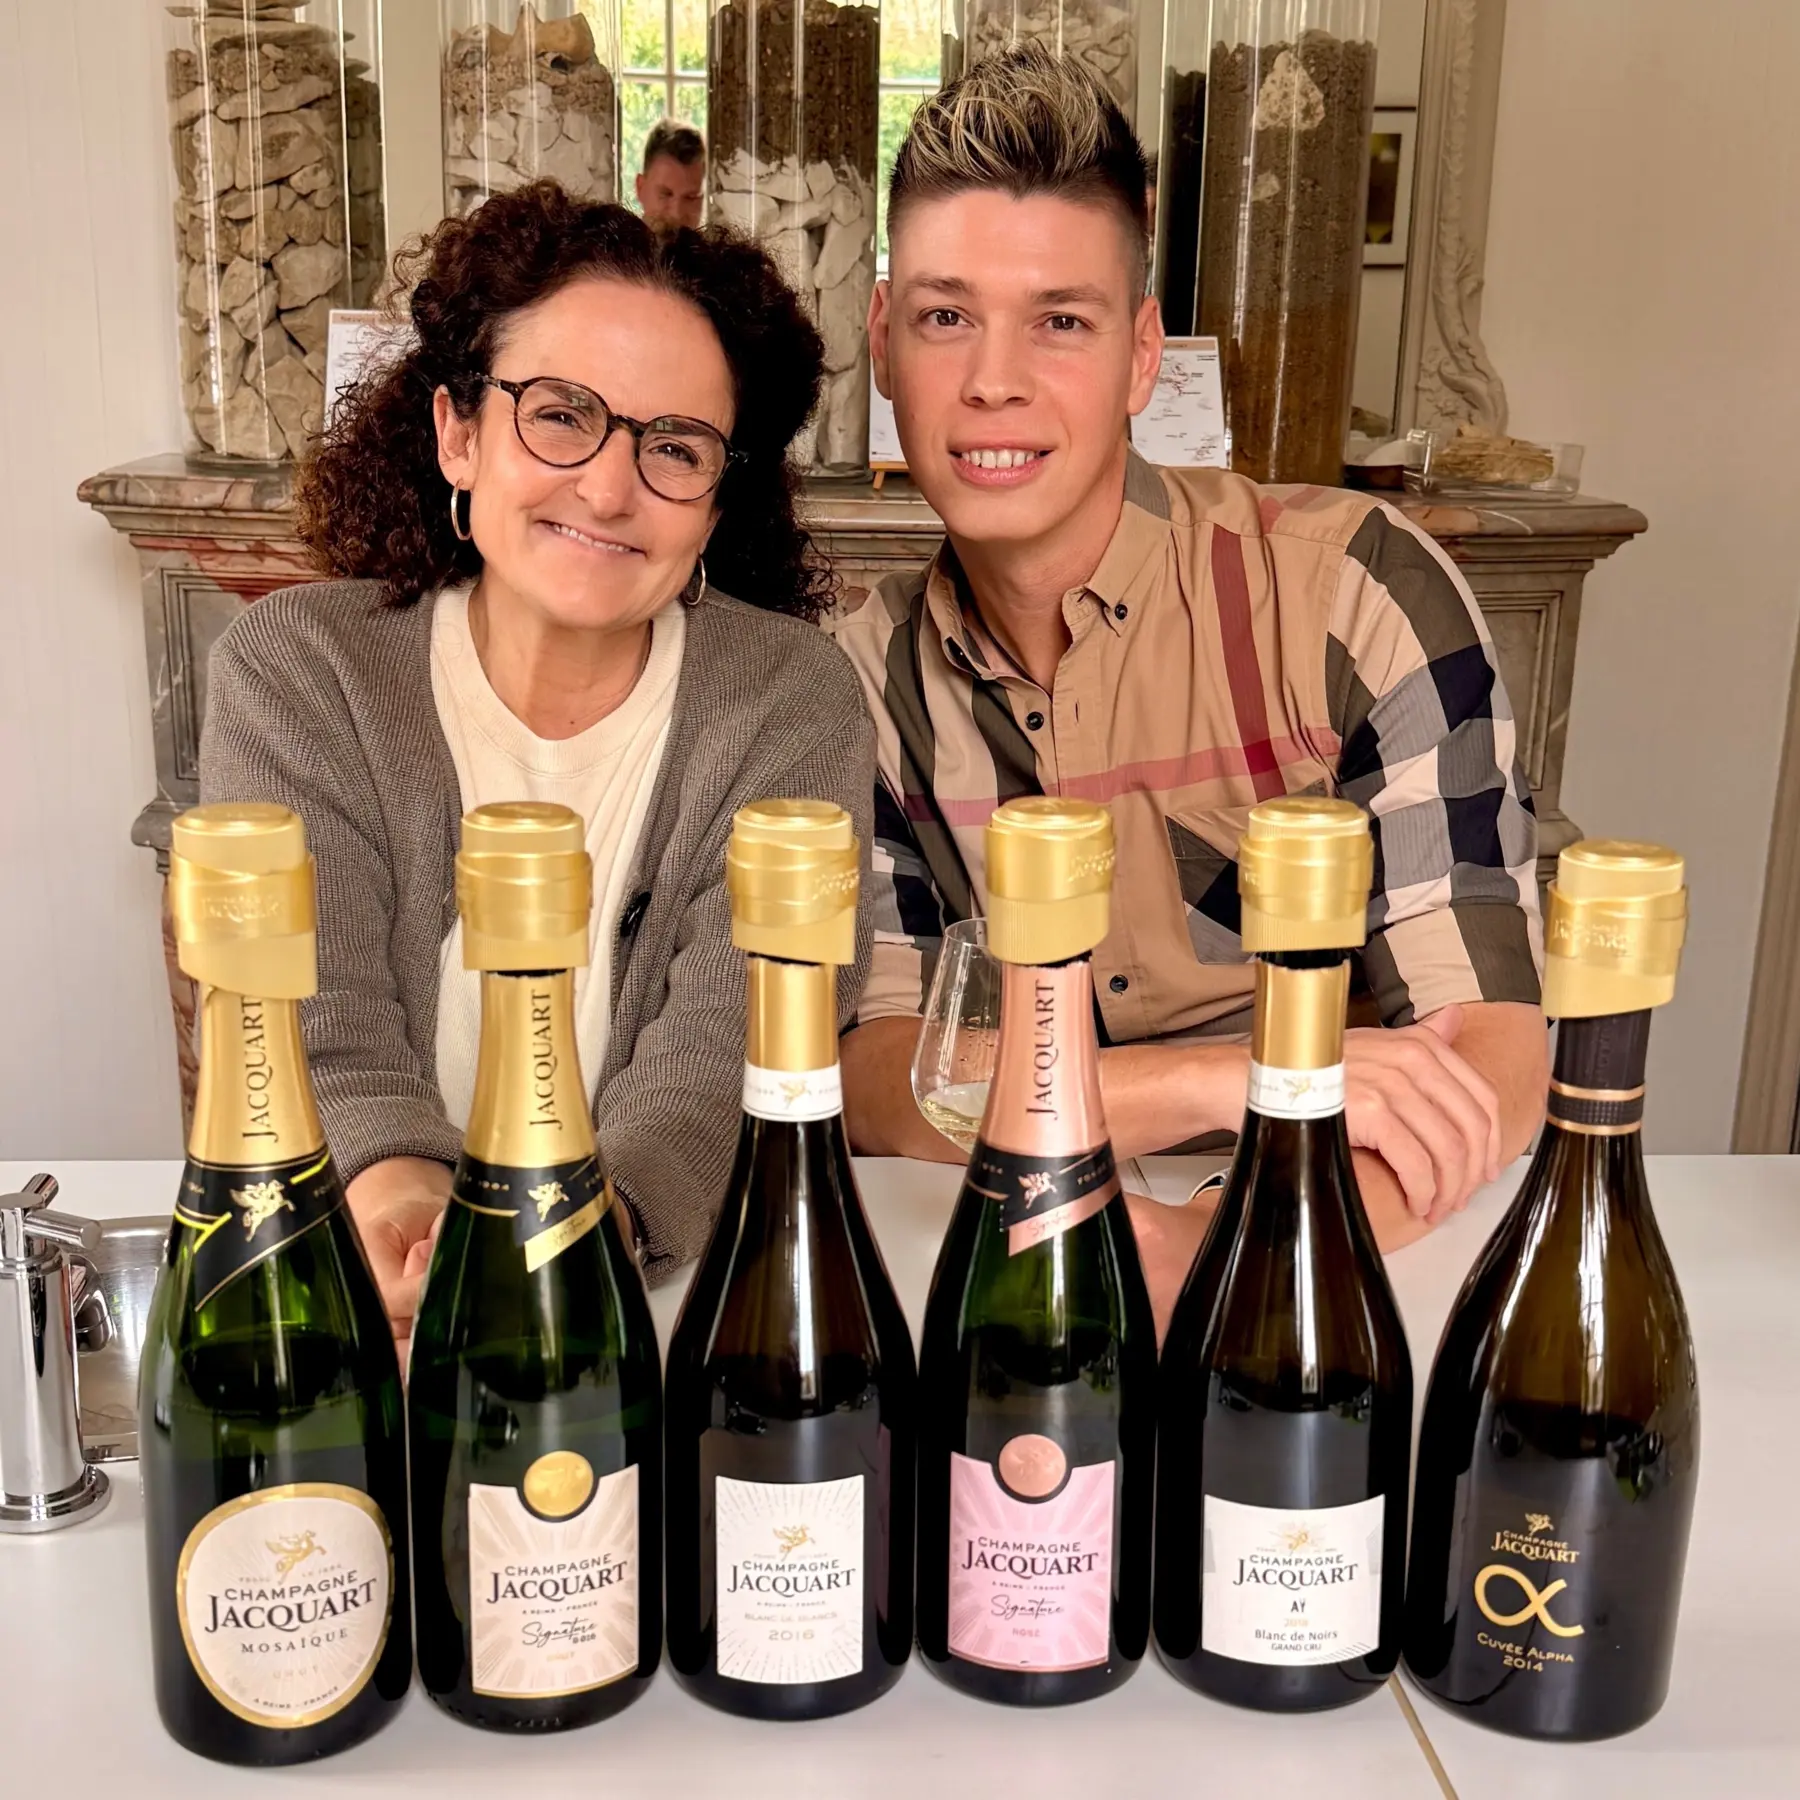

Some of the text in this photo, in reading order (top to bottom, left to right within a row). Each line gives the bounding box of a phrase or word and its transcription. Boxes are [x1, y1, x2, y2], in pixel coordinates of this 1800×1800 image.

[528, 989, 563, 1130] JACQUART
[1026, 978, 1059, 1120] JACQUART
[241, 996, 279, 1143] JACQUART
[978, 1536, 1081, 1553] CHAMPAGNE
[1491, 1531, 1580, 1564] JACQUART
[1503, 1530, 1569, 1550] CHAMPAGNE
[504, 1553, 612, 1577] CHAMPAGNE
[742, 1559, 840, 1572] CHAMPAGNE
[961, 1539, 1099, 1580] JACQUART
[1232, 1558, 1358, 1591] JACQUART
[1249, 1554, 1344, 1566] CHAMPAGNE
[224, 1570, 358, 1601] CHAMPAGNE
[486, 1561, 628, 1604] JACQUART
[727, 1565, 856, 1598] JACQUART
[204, 1577, 378, 1634] JACQUART
[990, 1594, 1064, 1620] Signature
[522, 1617, 598, 1648] Signature
[768, 1629, 815, 1641] 2016
[1254, 1629, 1338, 1642] Blanc de Noirs
[1271, 1642, 1322, 1652] GRAND CRU
[1503, 1655, 1544, 1673] 2014
